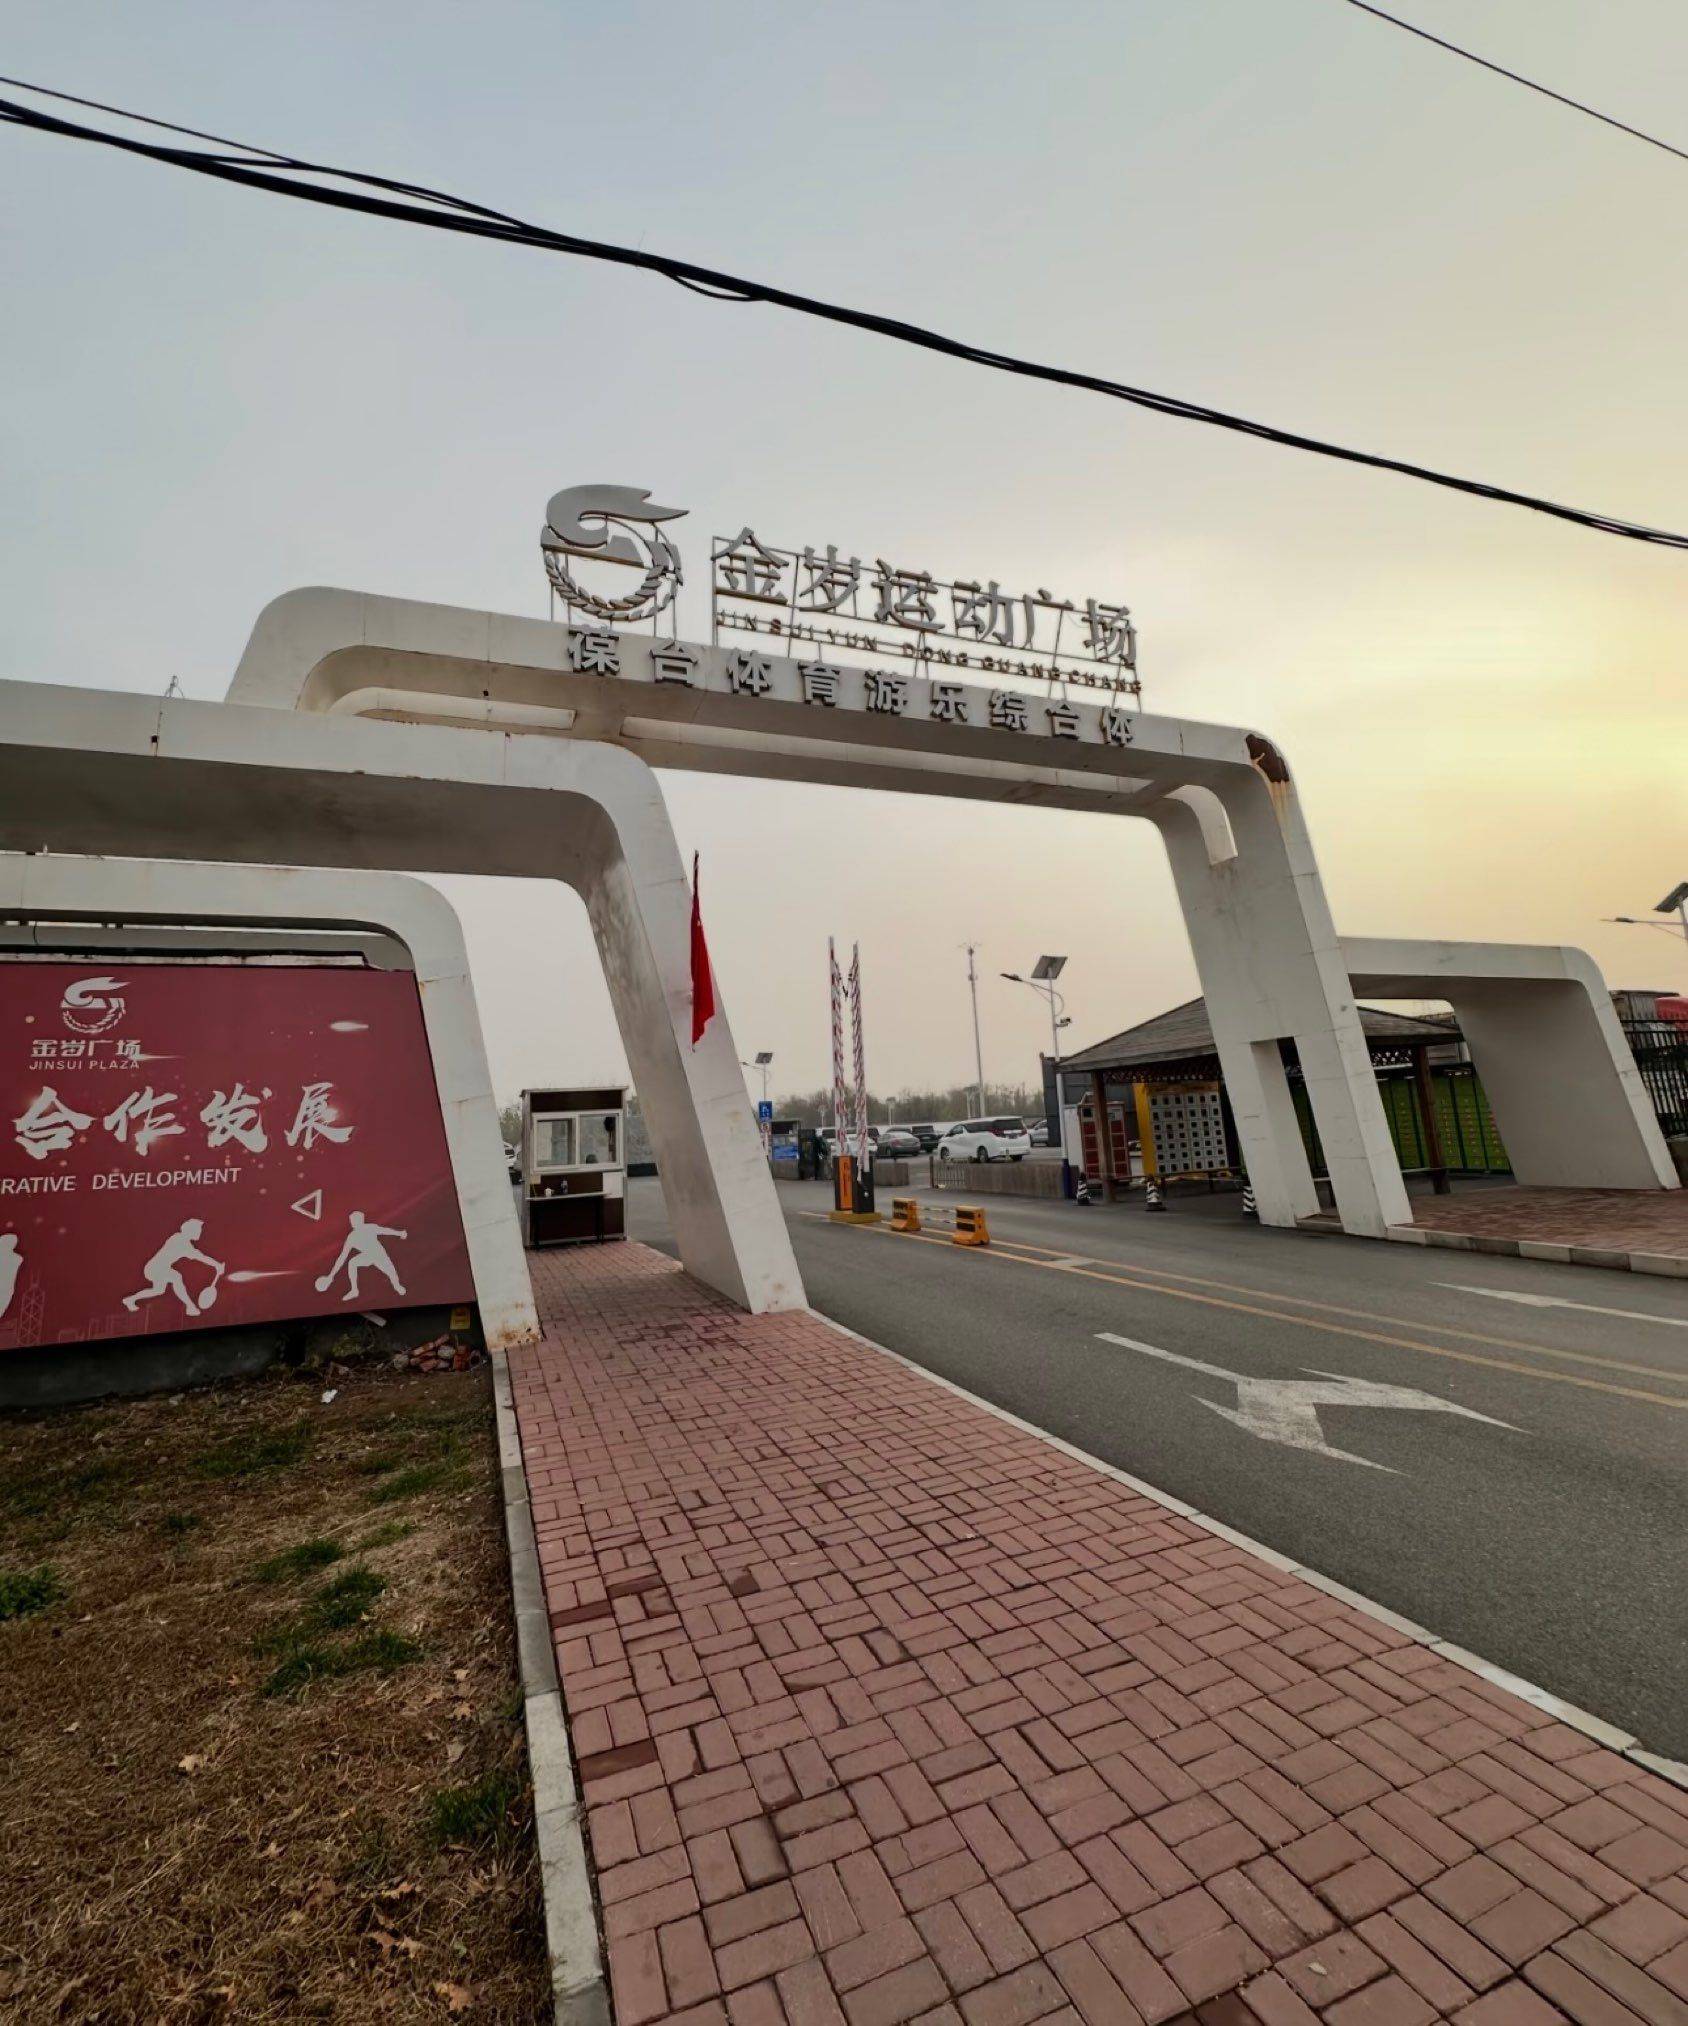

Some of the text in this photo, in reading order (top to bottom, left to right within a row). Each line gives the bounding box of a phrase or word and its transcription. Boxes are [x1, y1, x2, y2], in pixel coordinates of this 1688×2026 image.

[711, 526, 1138, 667] 金岁运动广场
[715, 608, 758, 632] JIN
[769, 618, 814, 642] SUI
[29, 1059, 140, 1071] JINSUI PLAZA
[13, 1082, 356, 1160] 合作发展
[92, 1167, 242, 1190] DEVELOPMENT
